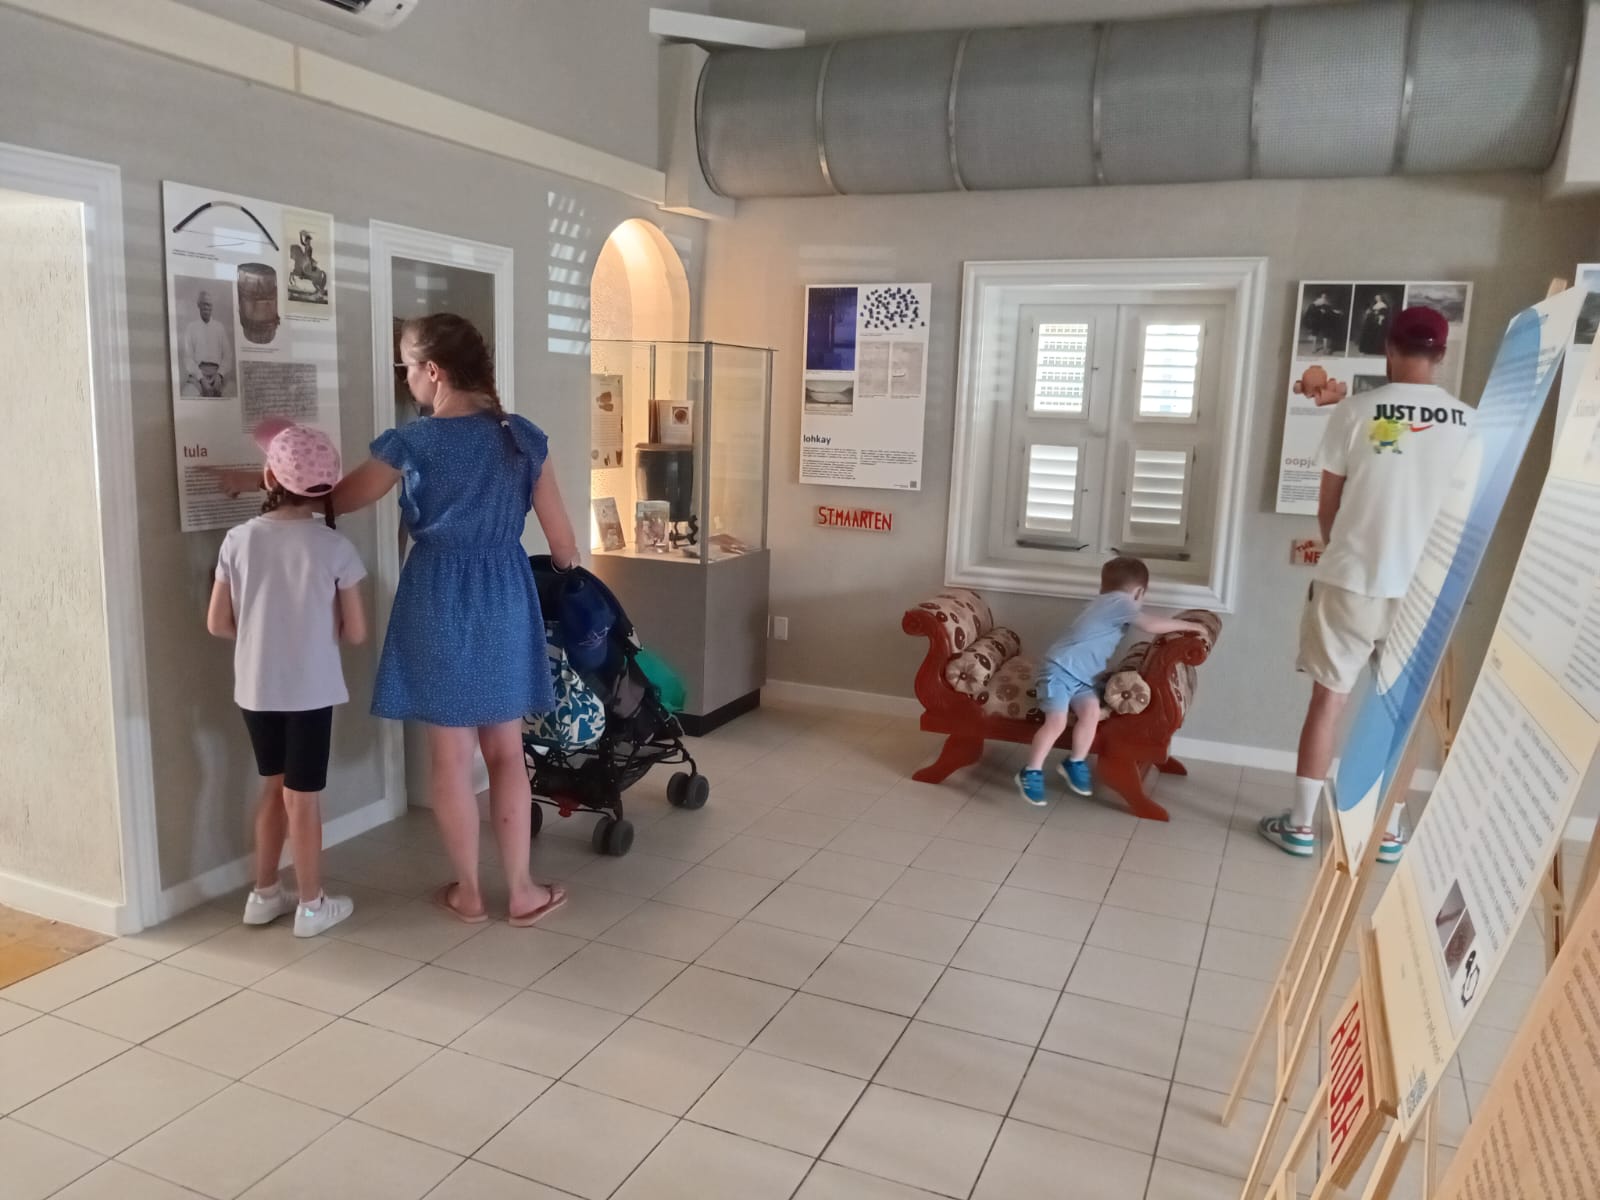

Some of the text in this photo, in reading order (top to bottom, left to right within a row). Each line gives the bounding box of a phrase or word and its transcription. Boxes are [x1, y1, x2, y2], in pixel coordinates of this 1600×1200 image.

[1373, 404, 1467, 427] JUST DO IT.
[803, 434, 831, 446] lohkay
[183, 444, 208, 458] tula
[1303, 551, 1321, 564] NE
[1330, 1000, 1365, 1166] ARUBA
